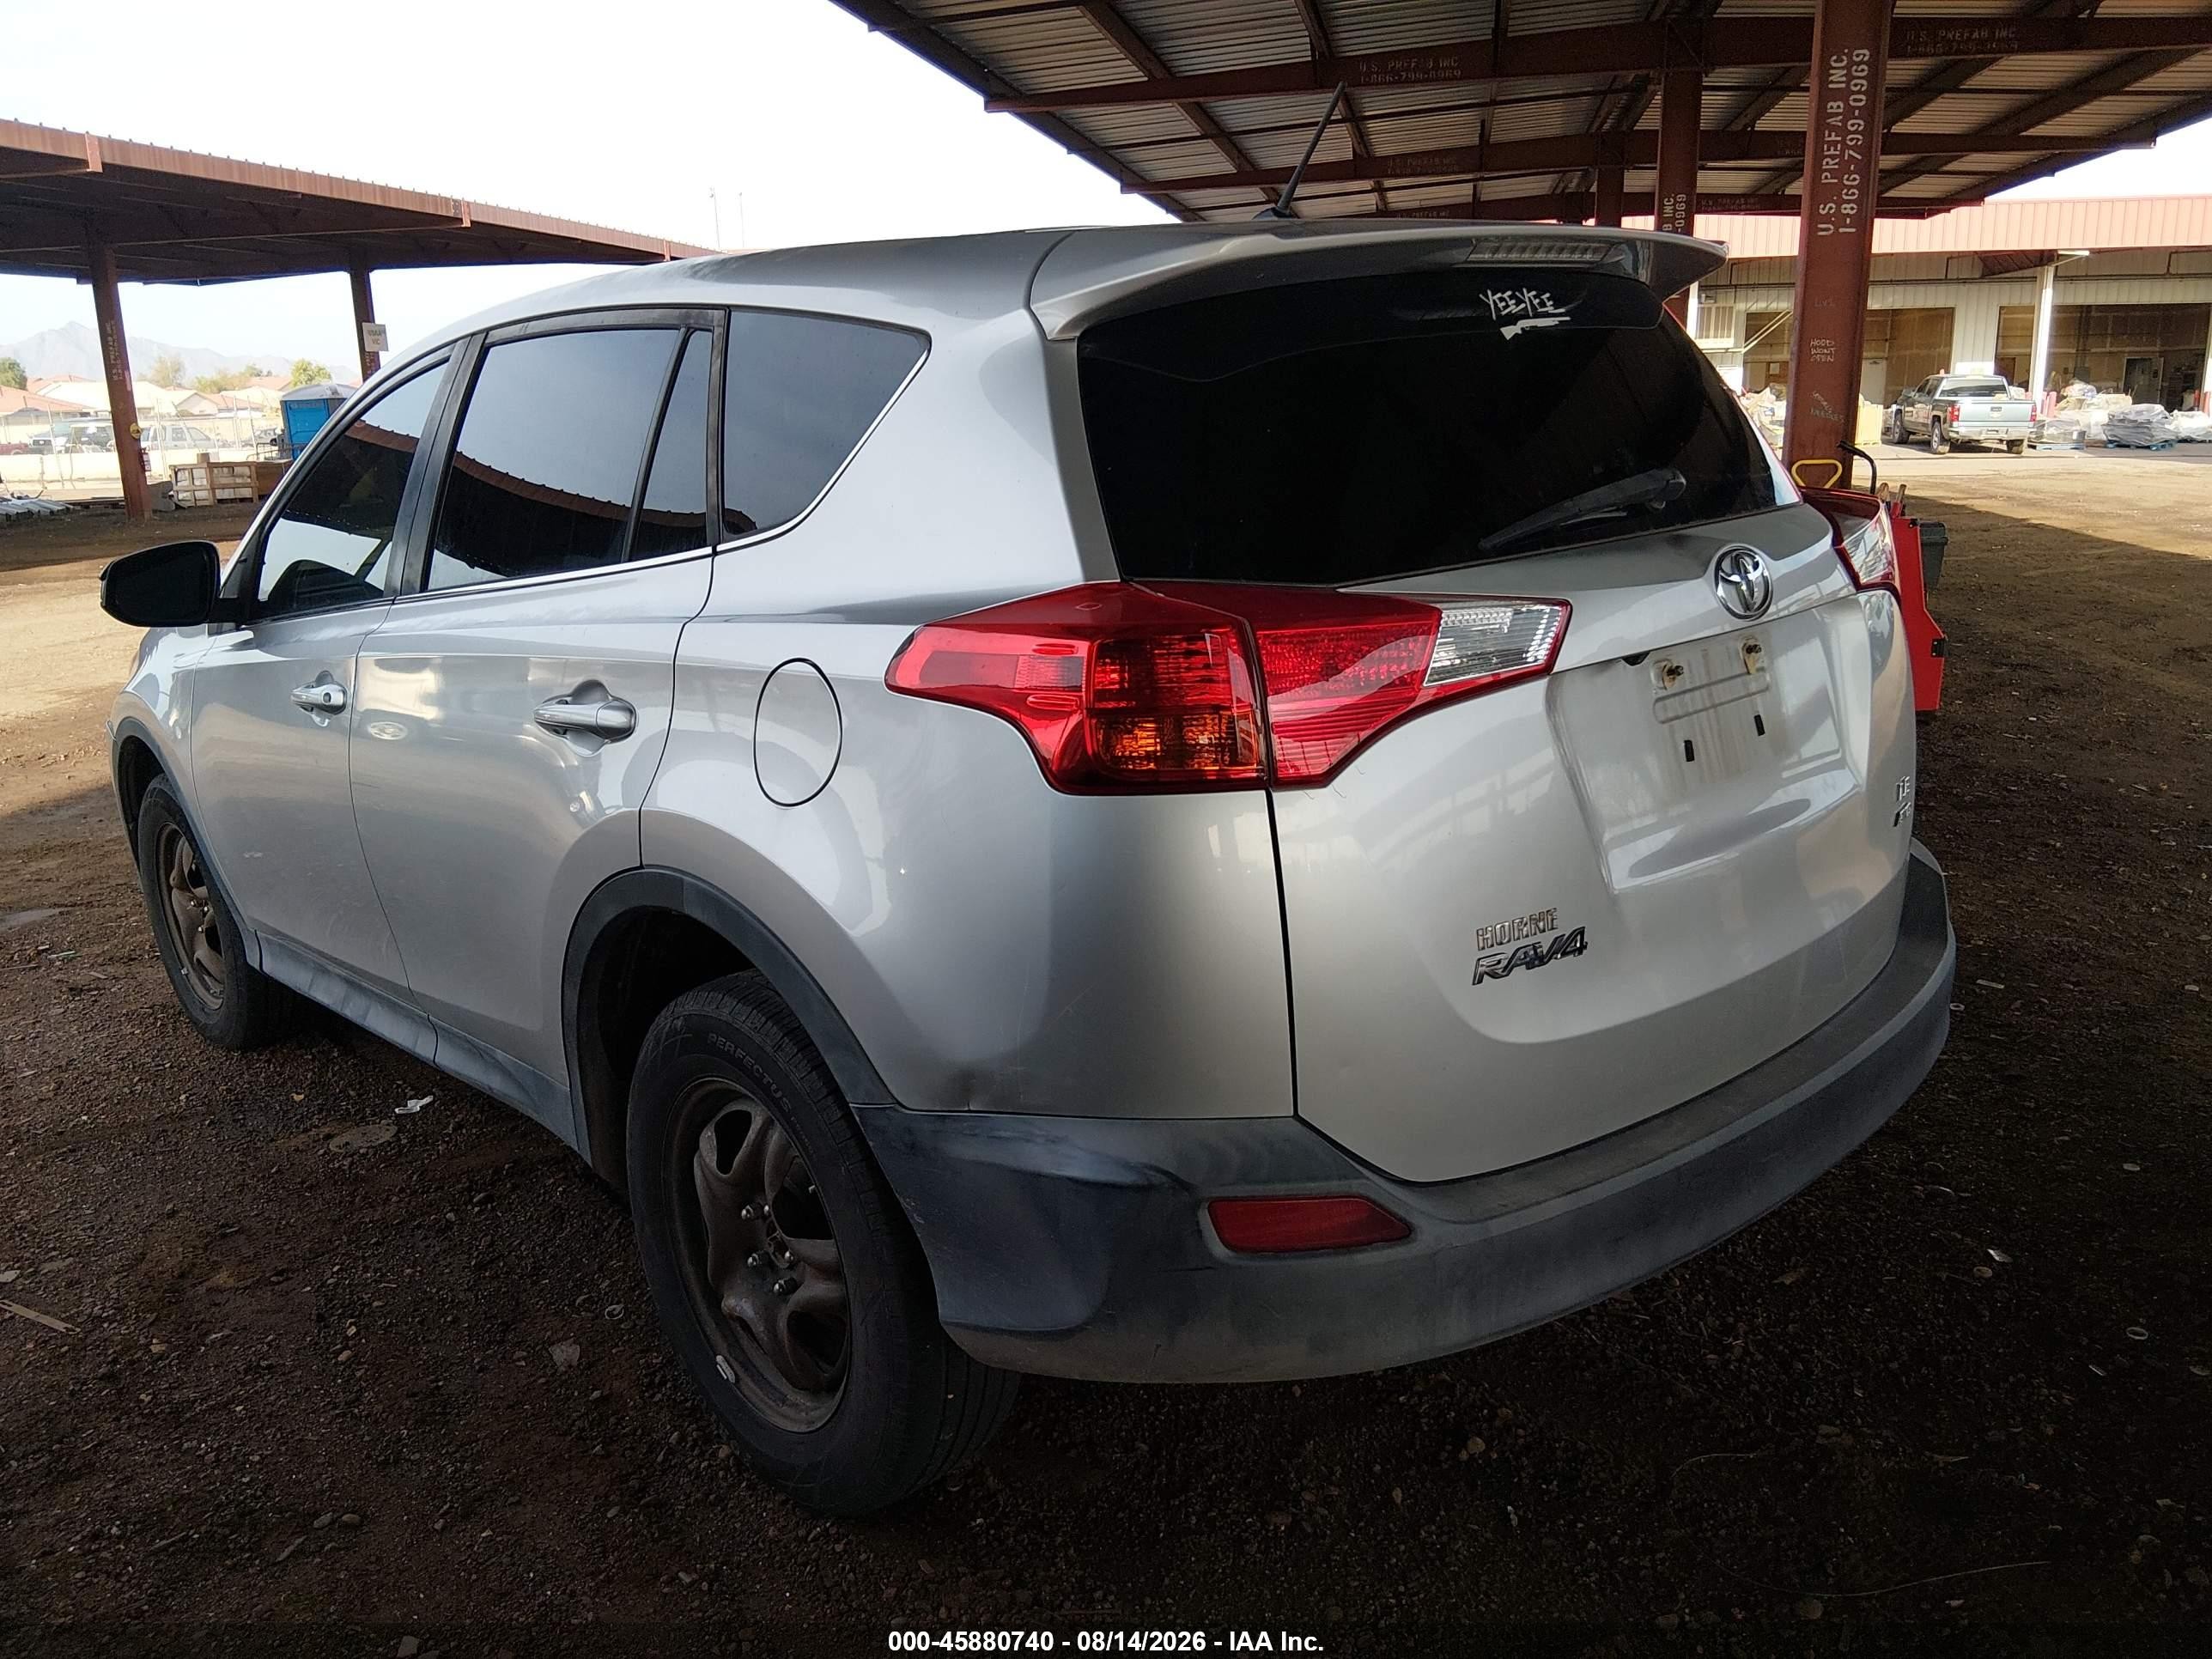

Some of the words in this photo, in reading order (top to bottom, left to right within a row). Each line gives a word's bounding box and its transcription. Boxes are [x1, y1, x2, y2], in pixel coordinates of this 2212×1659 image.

[1828, 48, 1849, 88] INC.
[1821, 100, 1844, 184] PREFAB
[1838, 48, 1870, 234] 1-866-799-0969
[1674, 194, 1686, 233] -0969
[1817, 196, 1837, 235] U.S.
[1810, 338, 1835, 347] HOOD
[1471, 926, 1589, 986] RAV4
[708, 1032, 792, 1113] PERFECTUS
